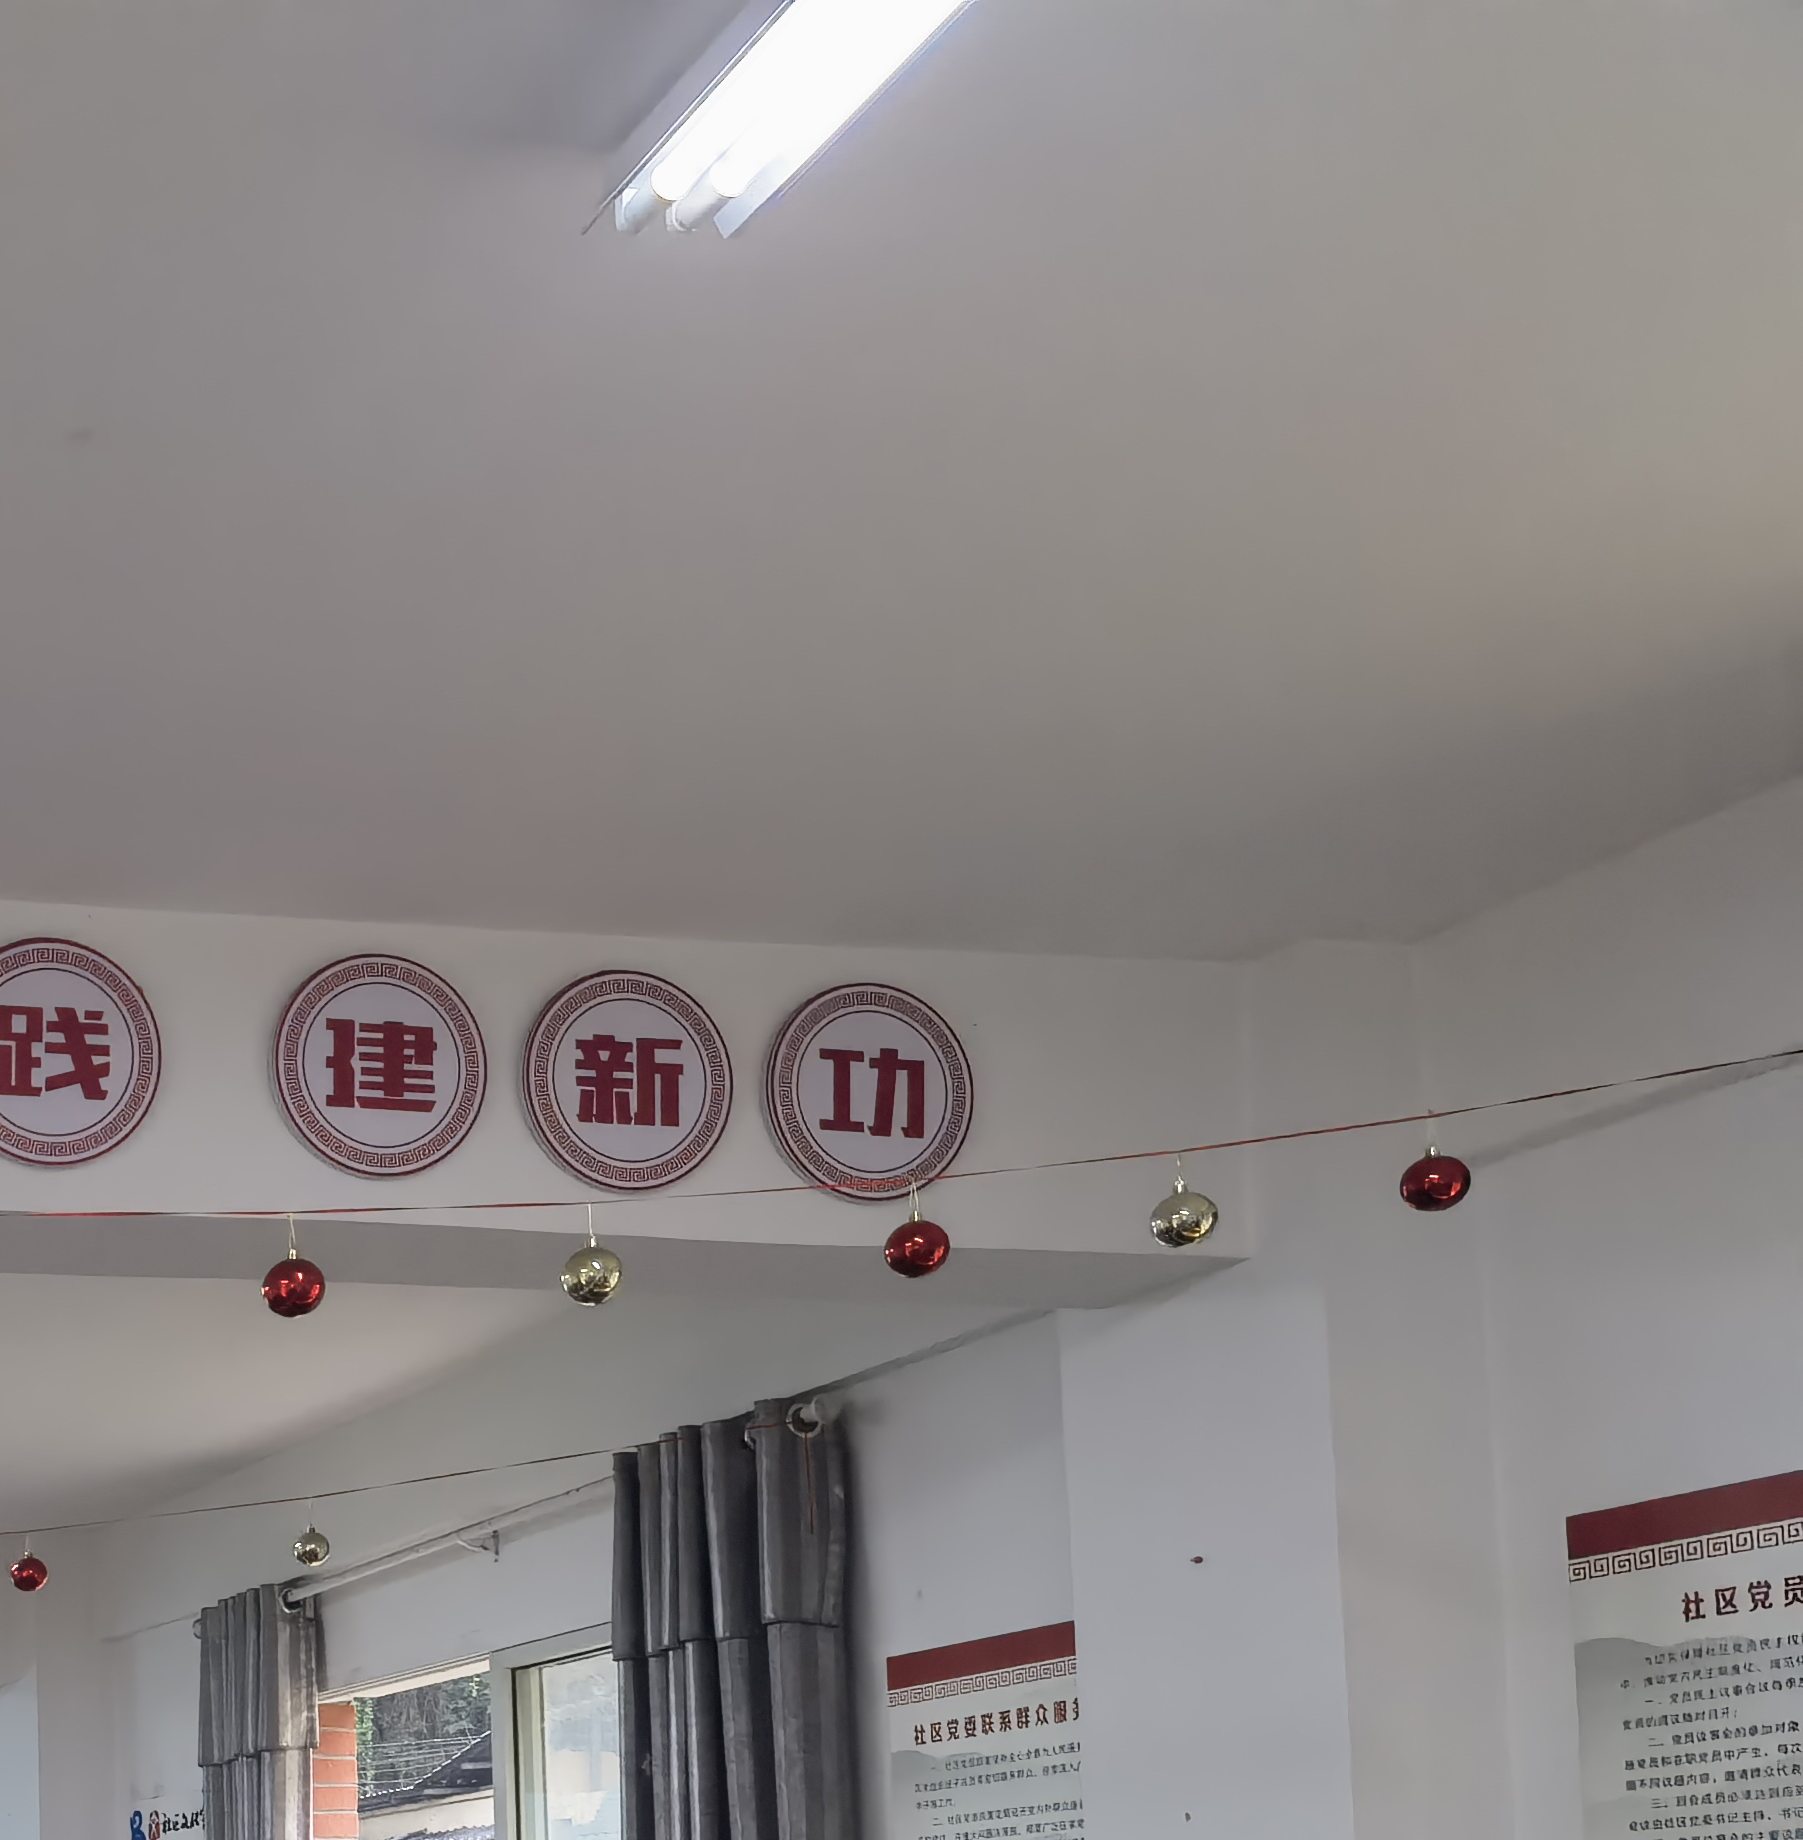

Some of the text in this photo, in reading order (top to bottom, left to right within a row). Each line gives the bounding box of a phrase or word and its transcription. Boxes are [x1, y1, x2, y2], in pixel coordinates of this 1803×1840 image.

[327, 1021, 925, 1140] 建新功
[1681, 1575, 1803, 1623] 社区党员
